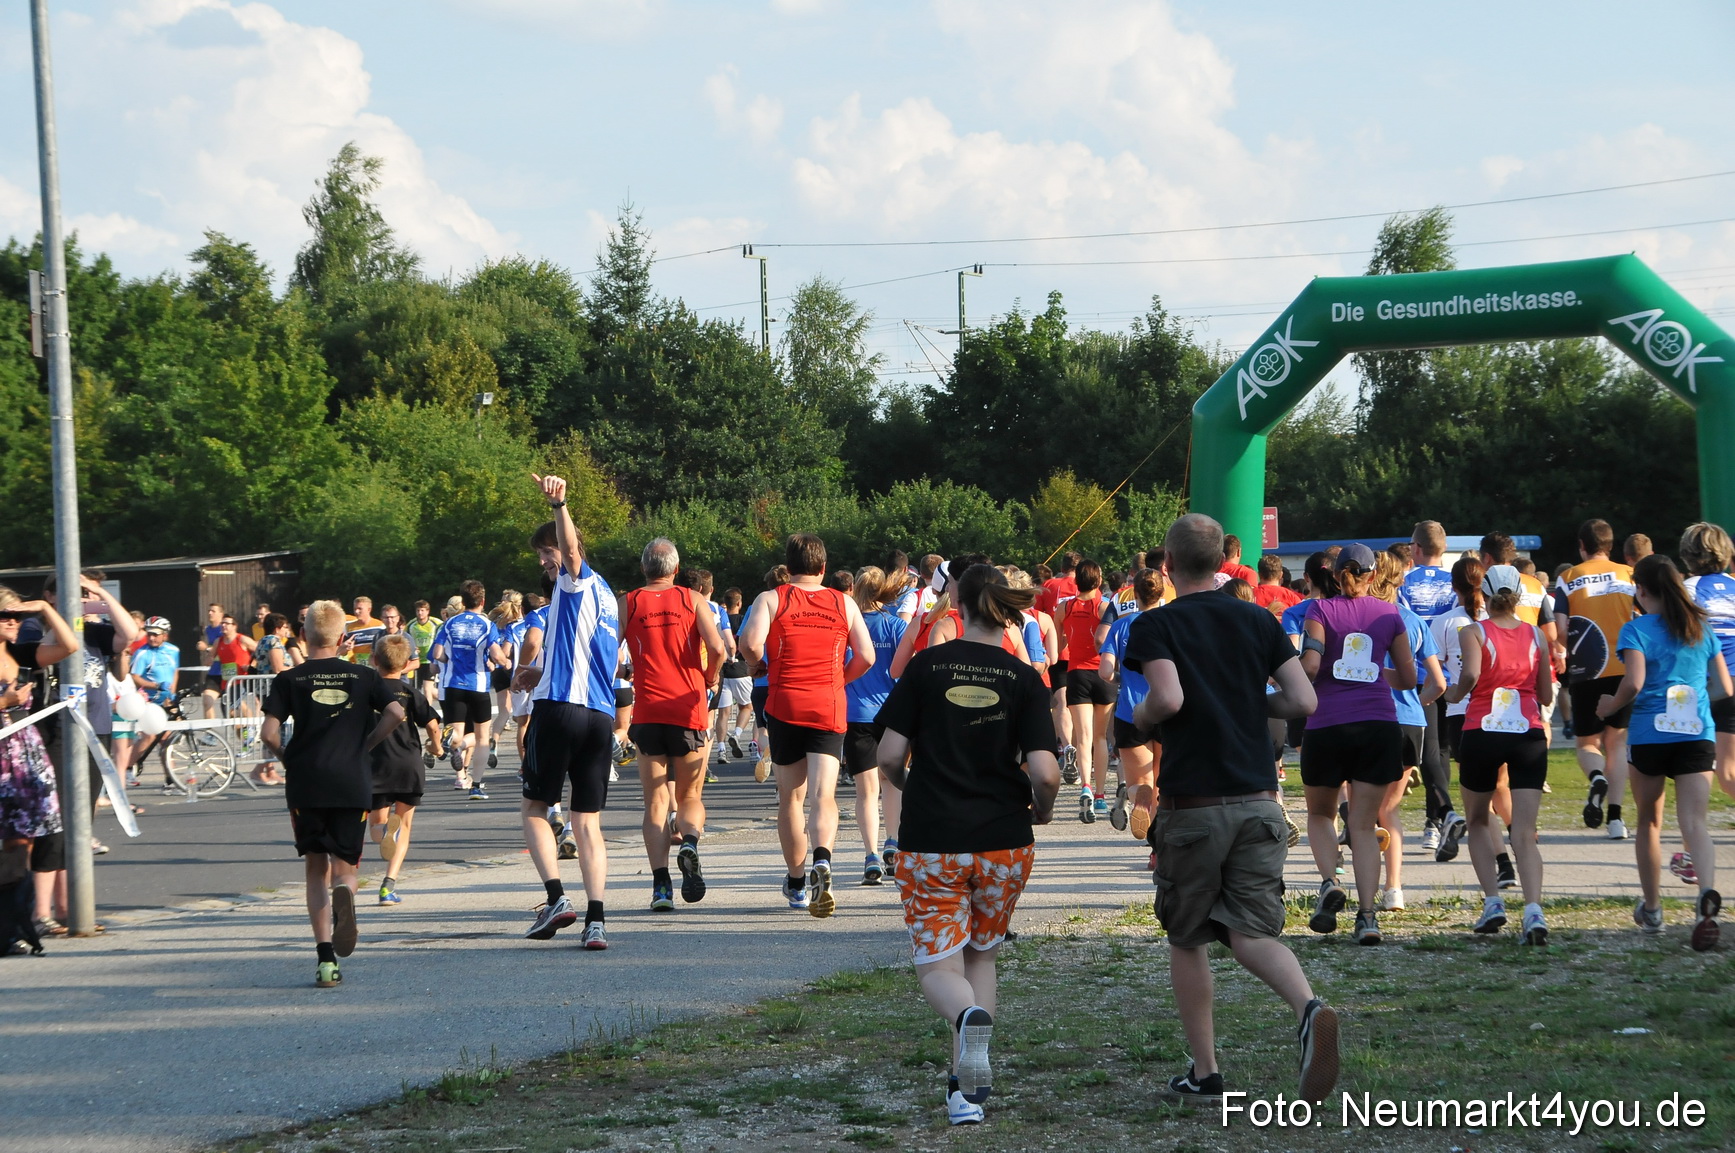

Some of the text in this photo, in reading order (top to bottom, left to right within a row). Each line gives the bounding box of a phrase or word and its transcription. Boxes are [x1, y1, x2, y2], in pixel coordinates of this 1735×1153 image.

[1332, 290, 1582, 322] Die Gesundheitskasse.
[1607, 308, 1725, 394] AOK
[1237, 314, 1320, 421] AOK
[1567, 573, 1612, 591] Benzin
[648, 610, 682, 619] Sparkasse
[790, 611, 836, 623] SV Sparkasse
[932, 663, 1018, 680] DIE GOLDSCHMIEDE
[952, 672, 997, 683] Jutta Rother
